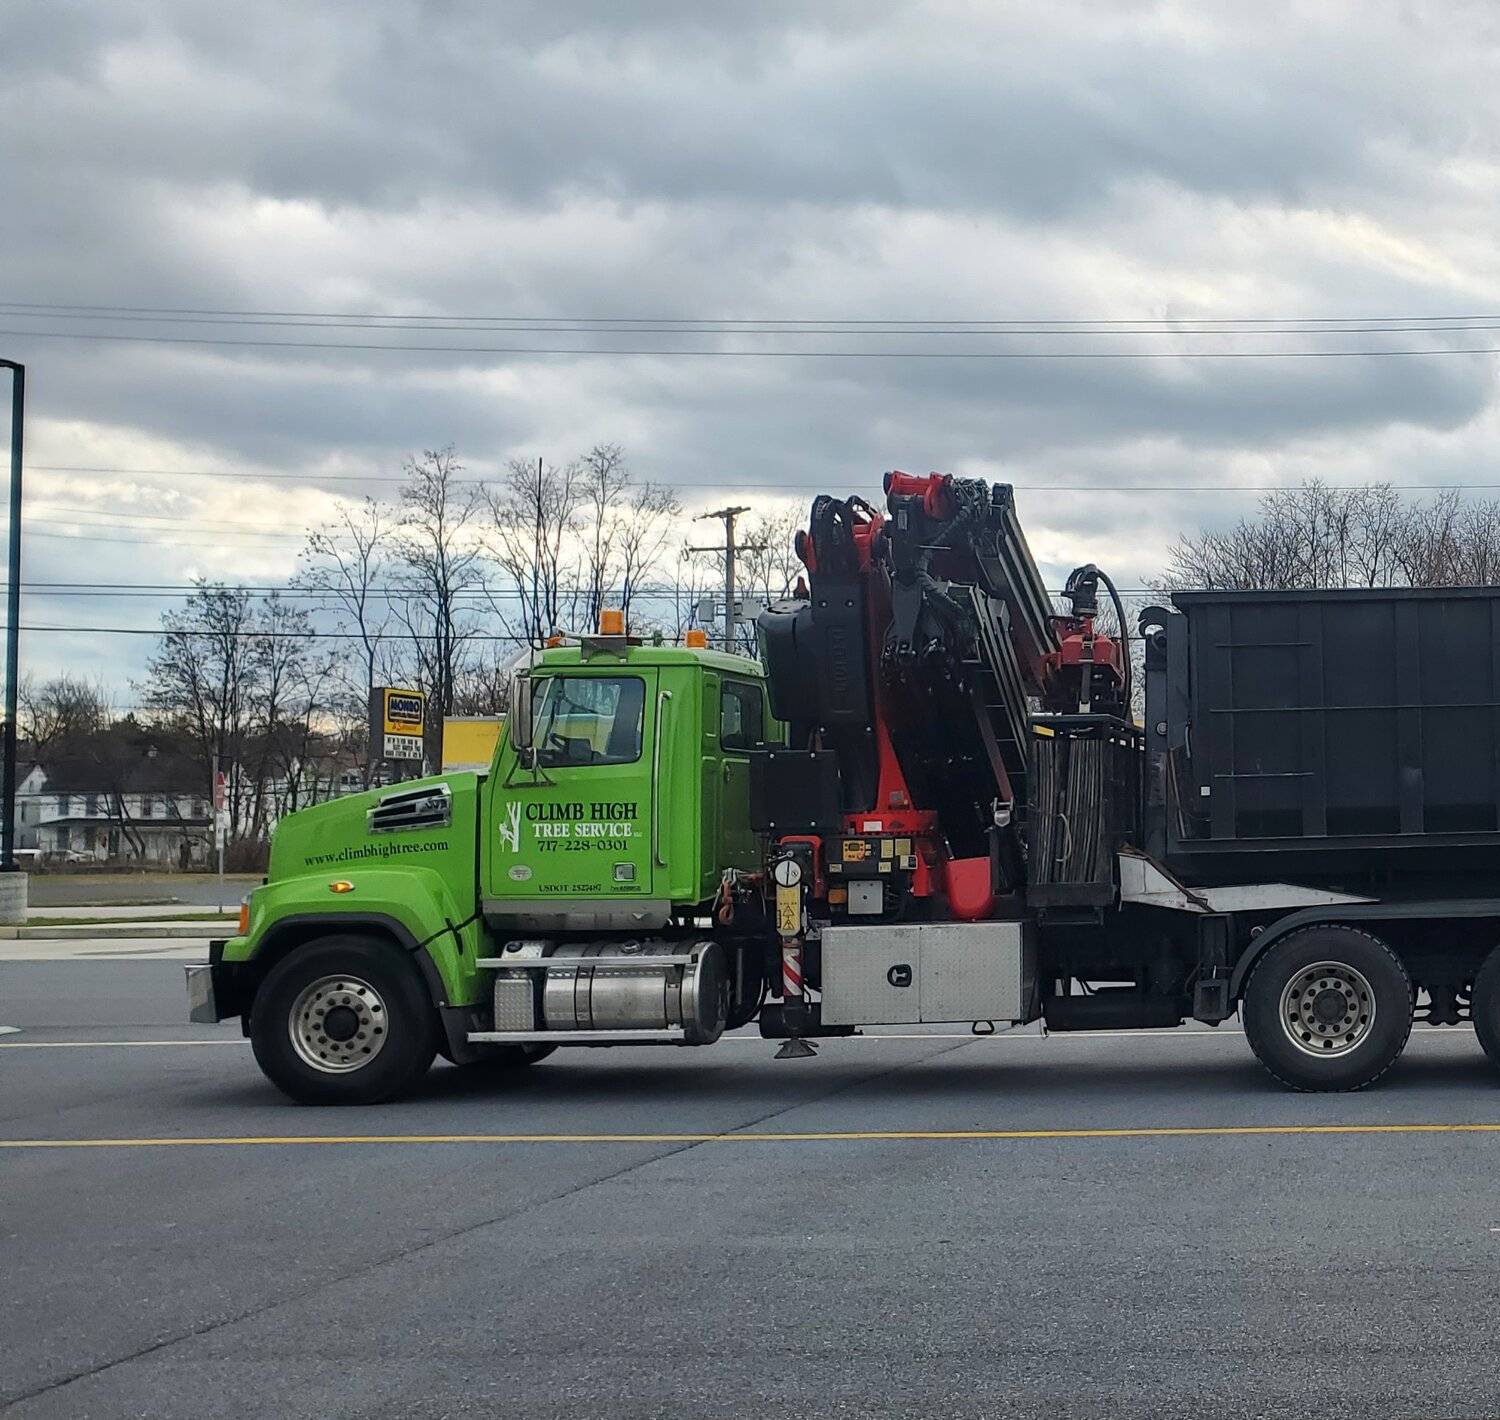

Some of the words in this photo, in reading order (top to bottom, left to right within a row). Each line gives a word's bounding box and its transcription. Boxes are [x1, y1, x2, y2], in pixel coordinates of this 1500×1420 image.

[526, 803, 584, 820] CLIMB
[591, 803, 638, 820] HIGH
[532, 823, 570, 838] TREE
[575, 823, 632, 838] SERVICE
[304, 841, 449, 866] www.climbhightree.com
[538, 840, 627, 852] 717-228-0301
